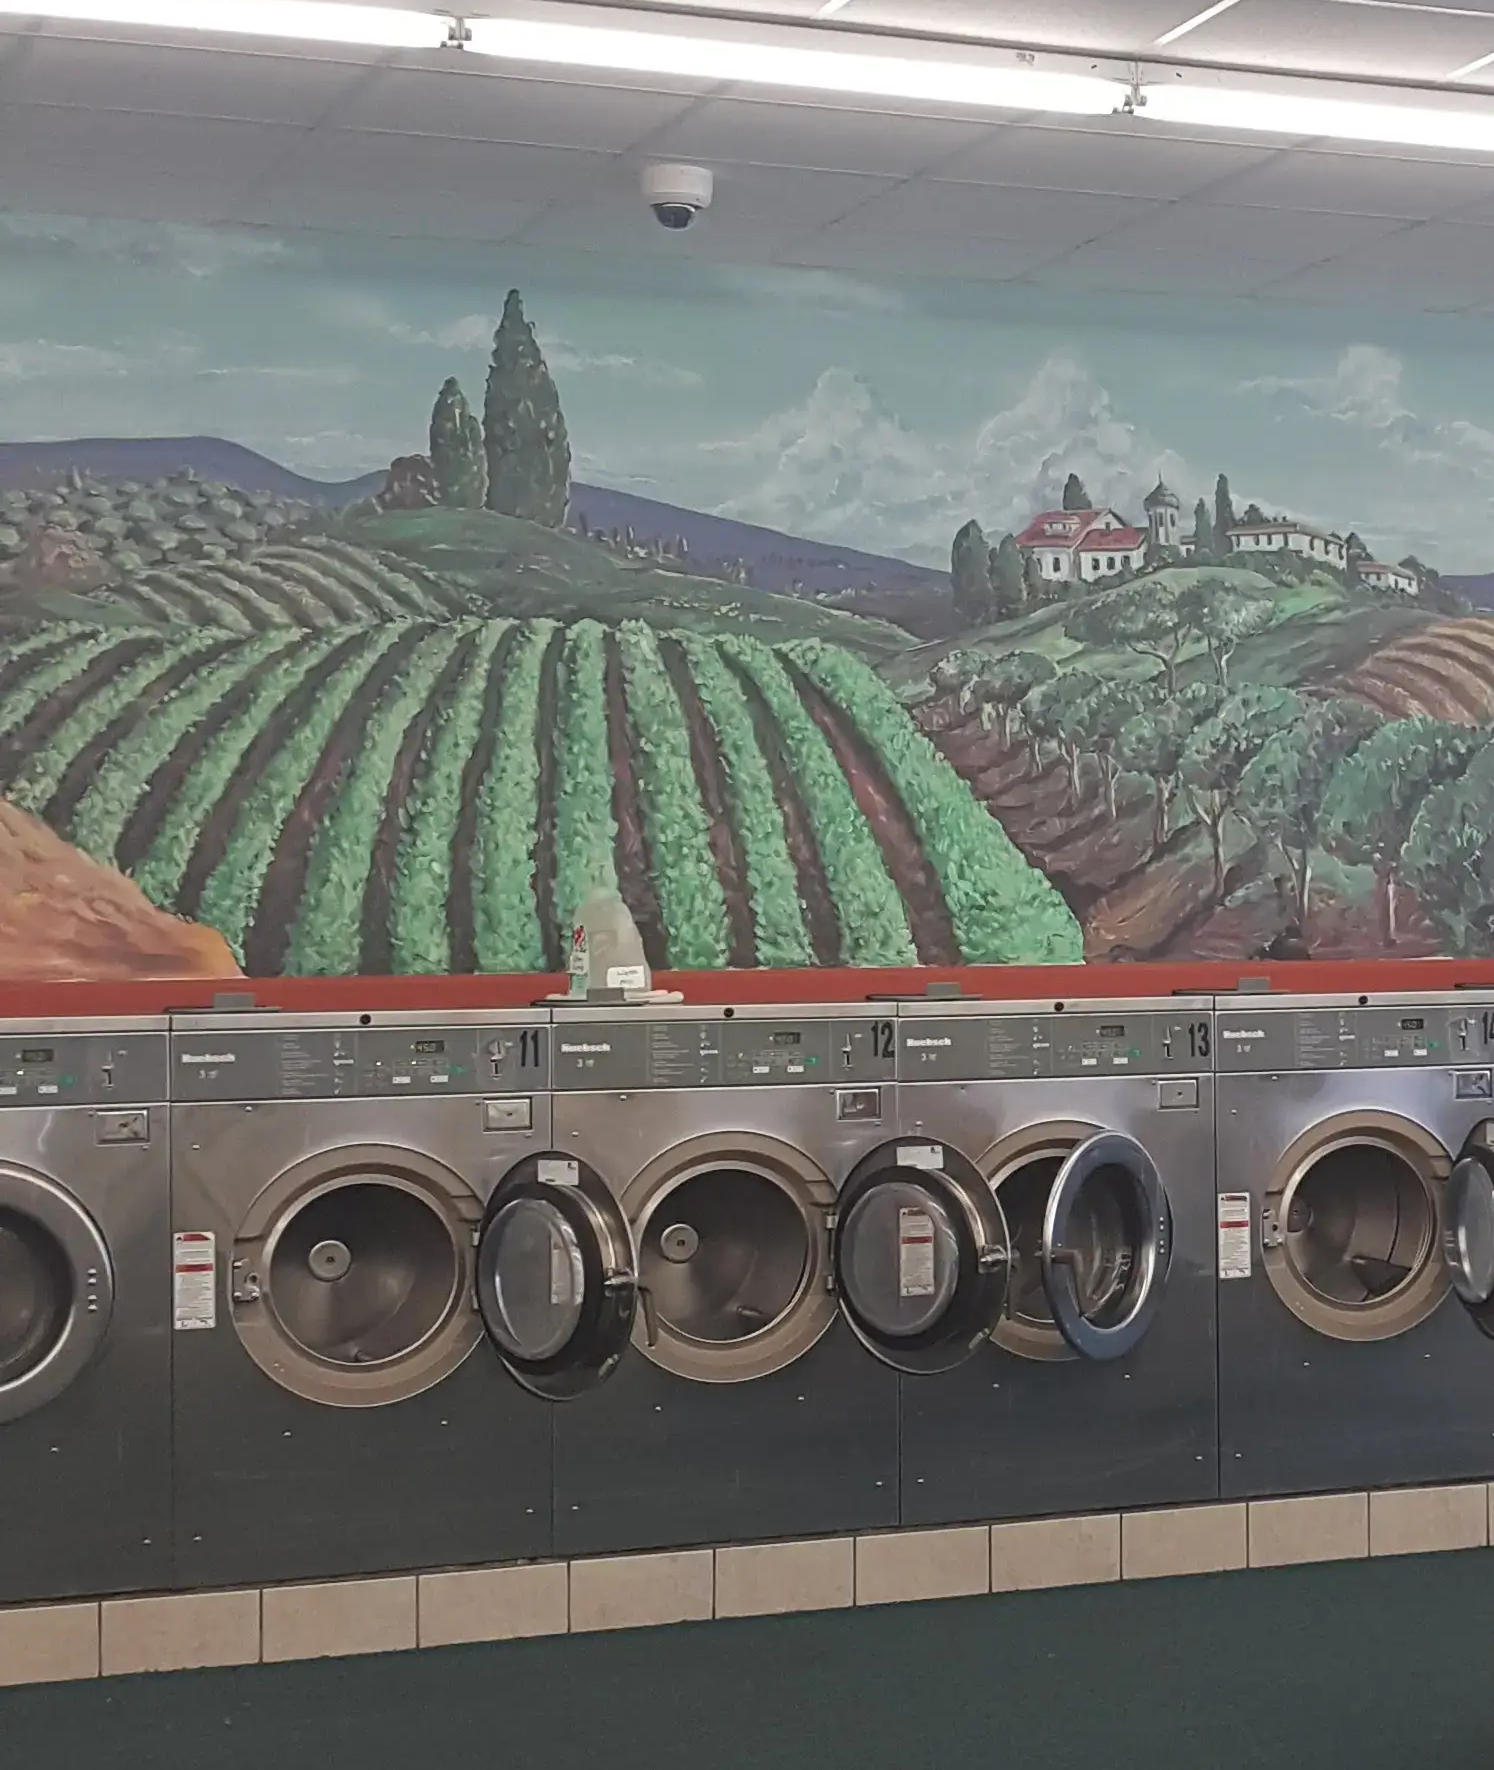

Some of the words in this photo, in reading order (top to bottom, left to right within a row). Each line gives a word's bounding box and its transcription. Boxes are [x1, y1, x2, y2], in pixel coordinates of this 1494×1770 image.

[520, 1030, 539, 1067] 11
[871, 1021, 895, 1058] 12
[1188, 1022, 1210, 1057] 13
